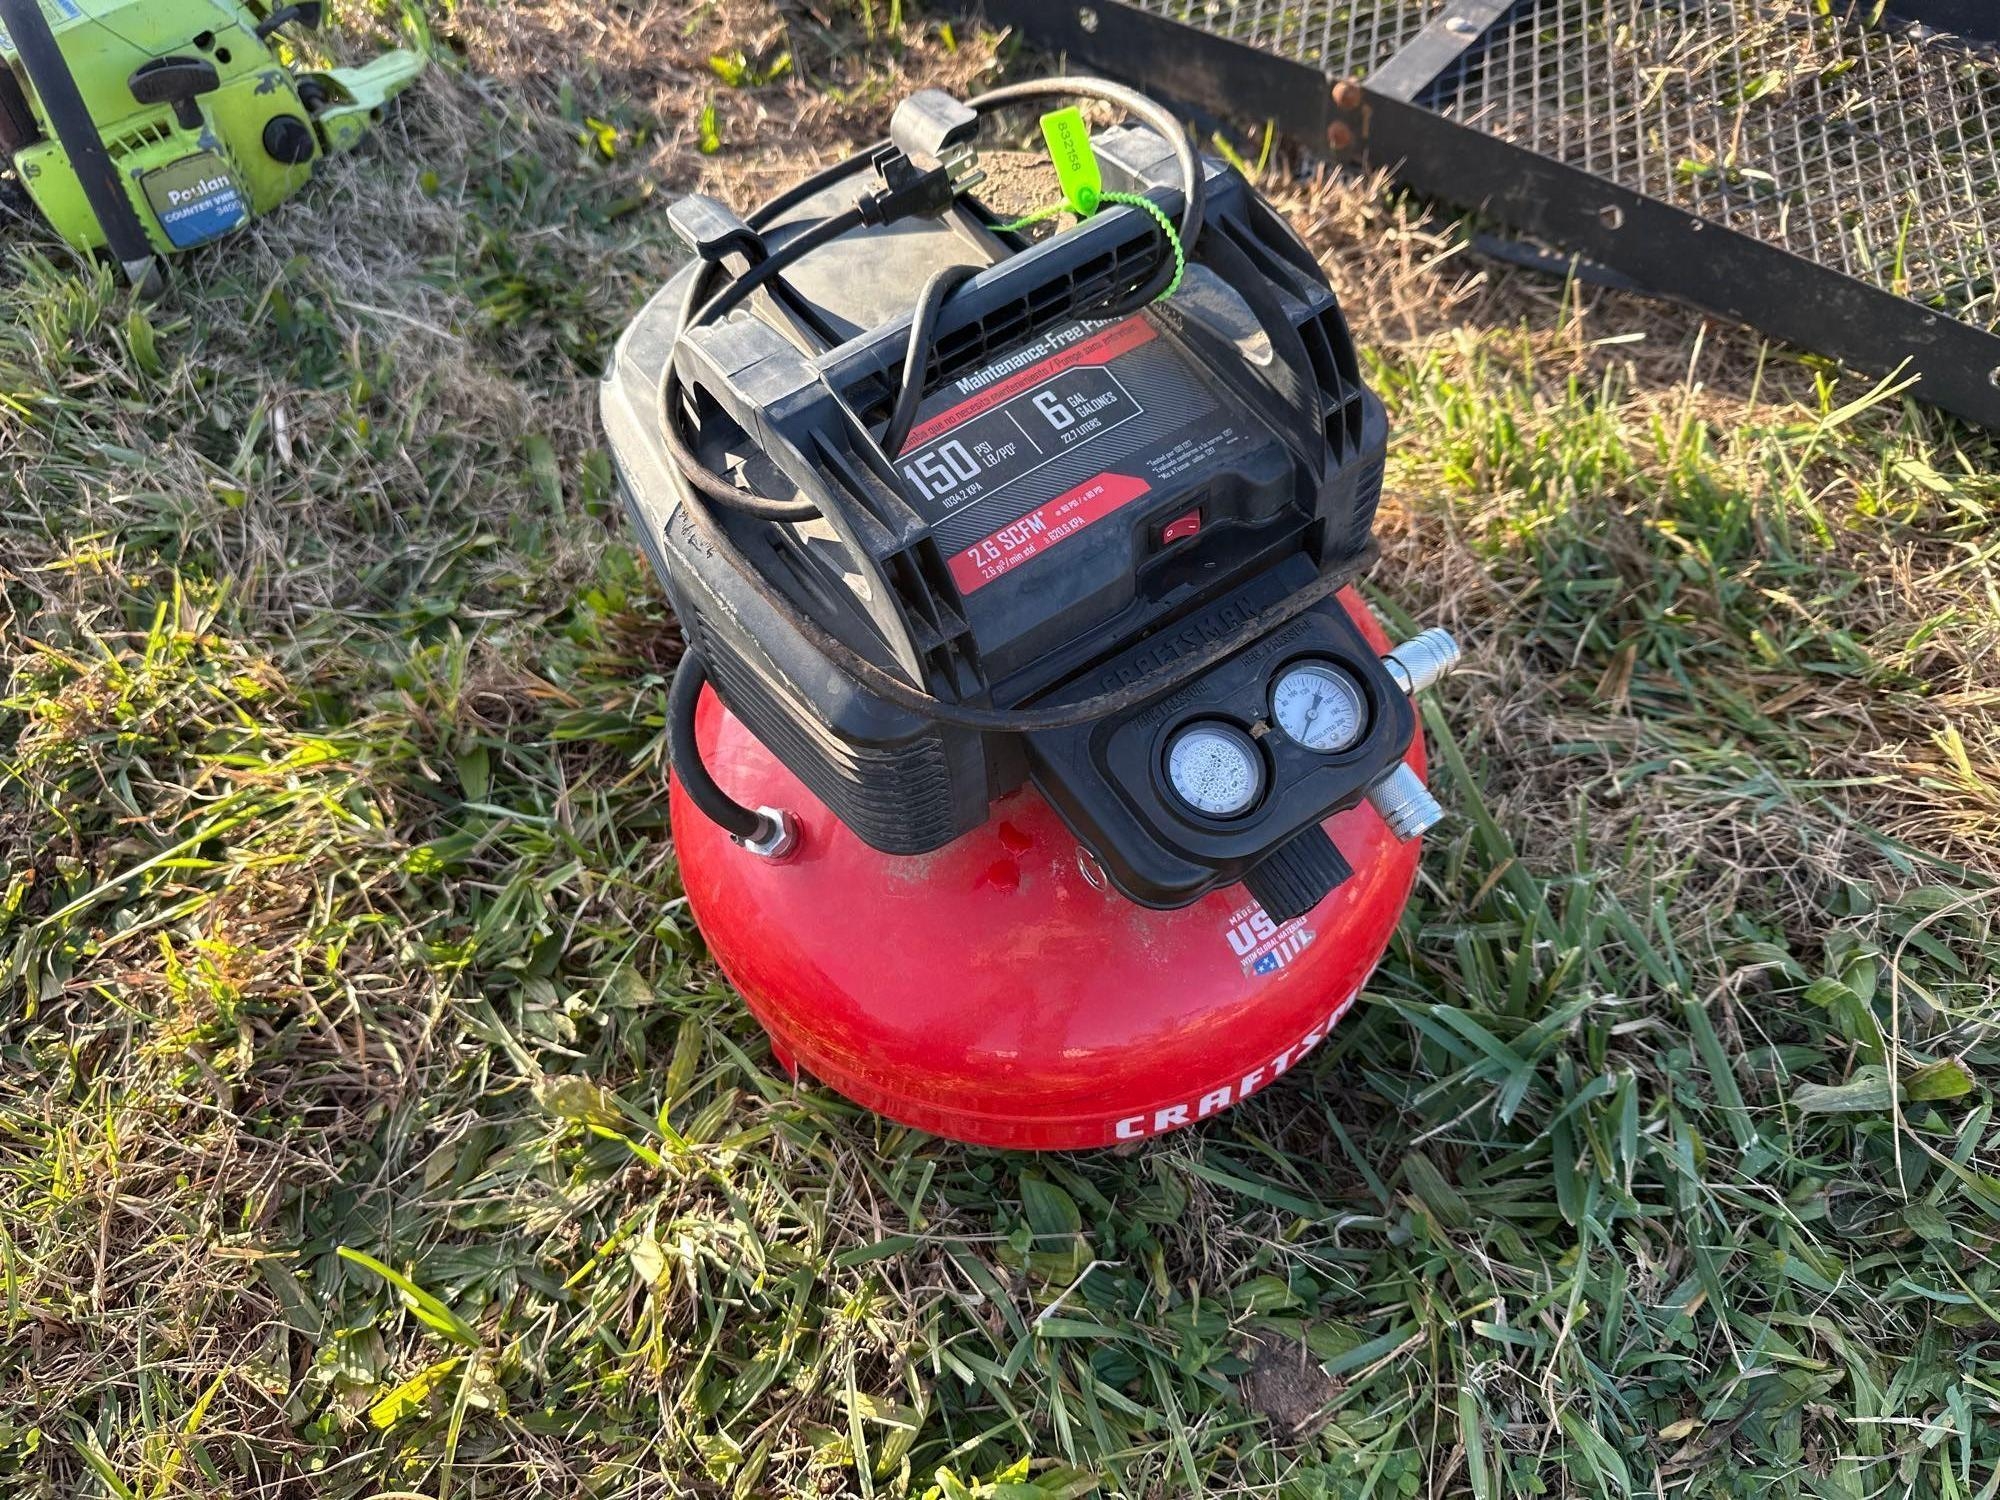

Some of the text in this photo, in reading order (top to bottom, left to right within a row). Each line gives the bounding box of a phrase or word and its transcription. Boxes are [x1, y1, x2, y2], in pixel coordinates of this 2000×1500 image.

[1057, 121, 1081, 172] 832158
[955, 316, 1124, 395] Maintenance-Free Pu
[1032, 390, 1075, 430] 6
[1066, 392, 1088, 408] GAL
[1075, 391, 1118, 418] GALONES
[944, 414, 956, 426] no
[1076, 417, 1102, 436] LITERS
[973, 441, 993, 457] PSI
[903, 440, 981, 501] 150
[967, 482, 984, 496] KPA
[1069, 516, 1086, 531] KPA
[967, 540, 1000, 568] 2.6
[982, 565, 997, 580] 2.6
[1228, 905, 1253, 926] MADE
[1225, 908, 1288, 956] US
[1240, 915, 1308, 967] WITH GLOBAL MATERIALS
[1115, 961, 1377, 1140] CRAFTSM
